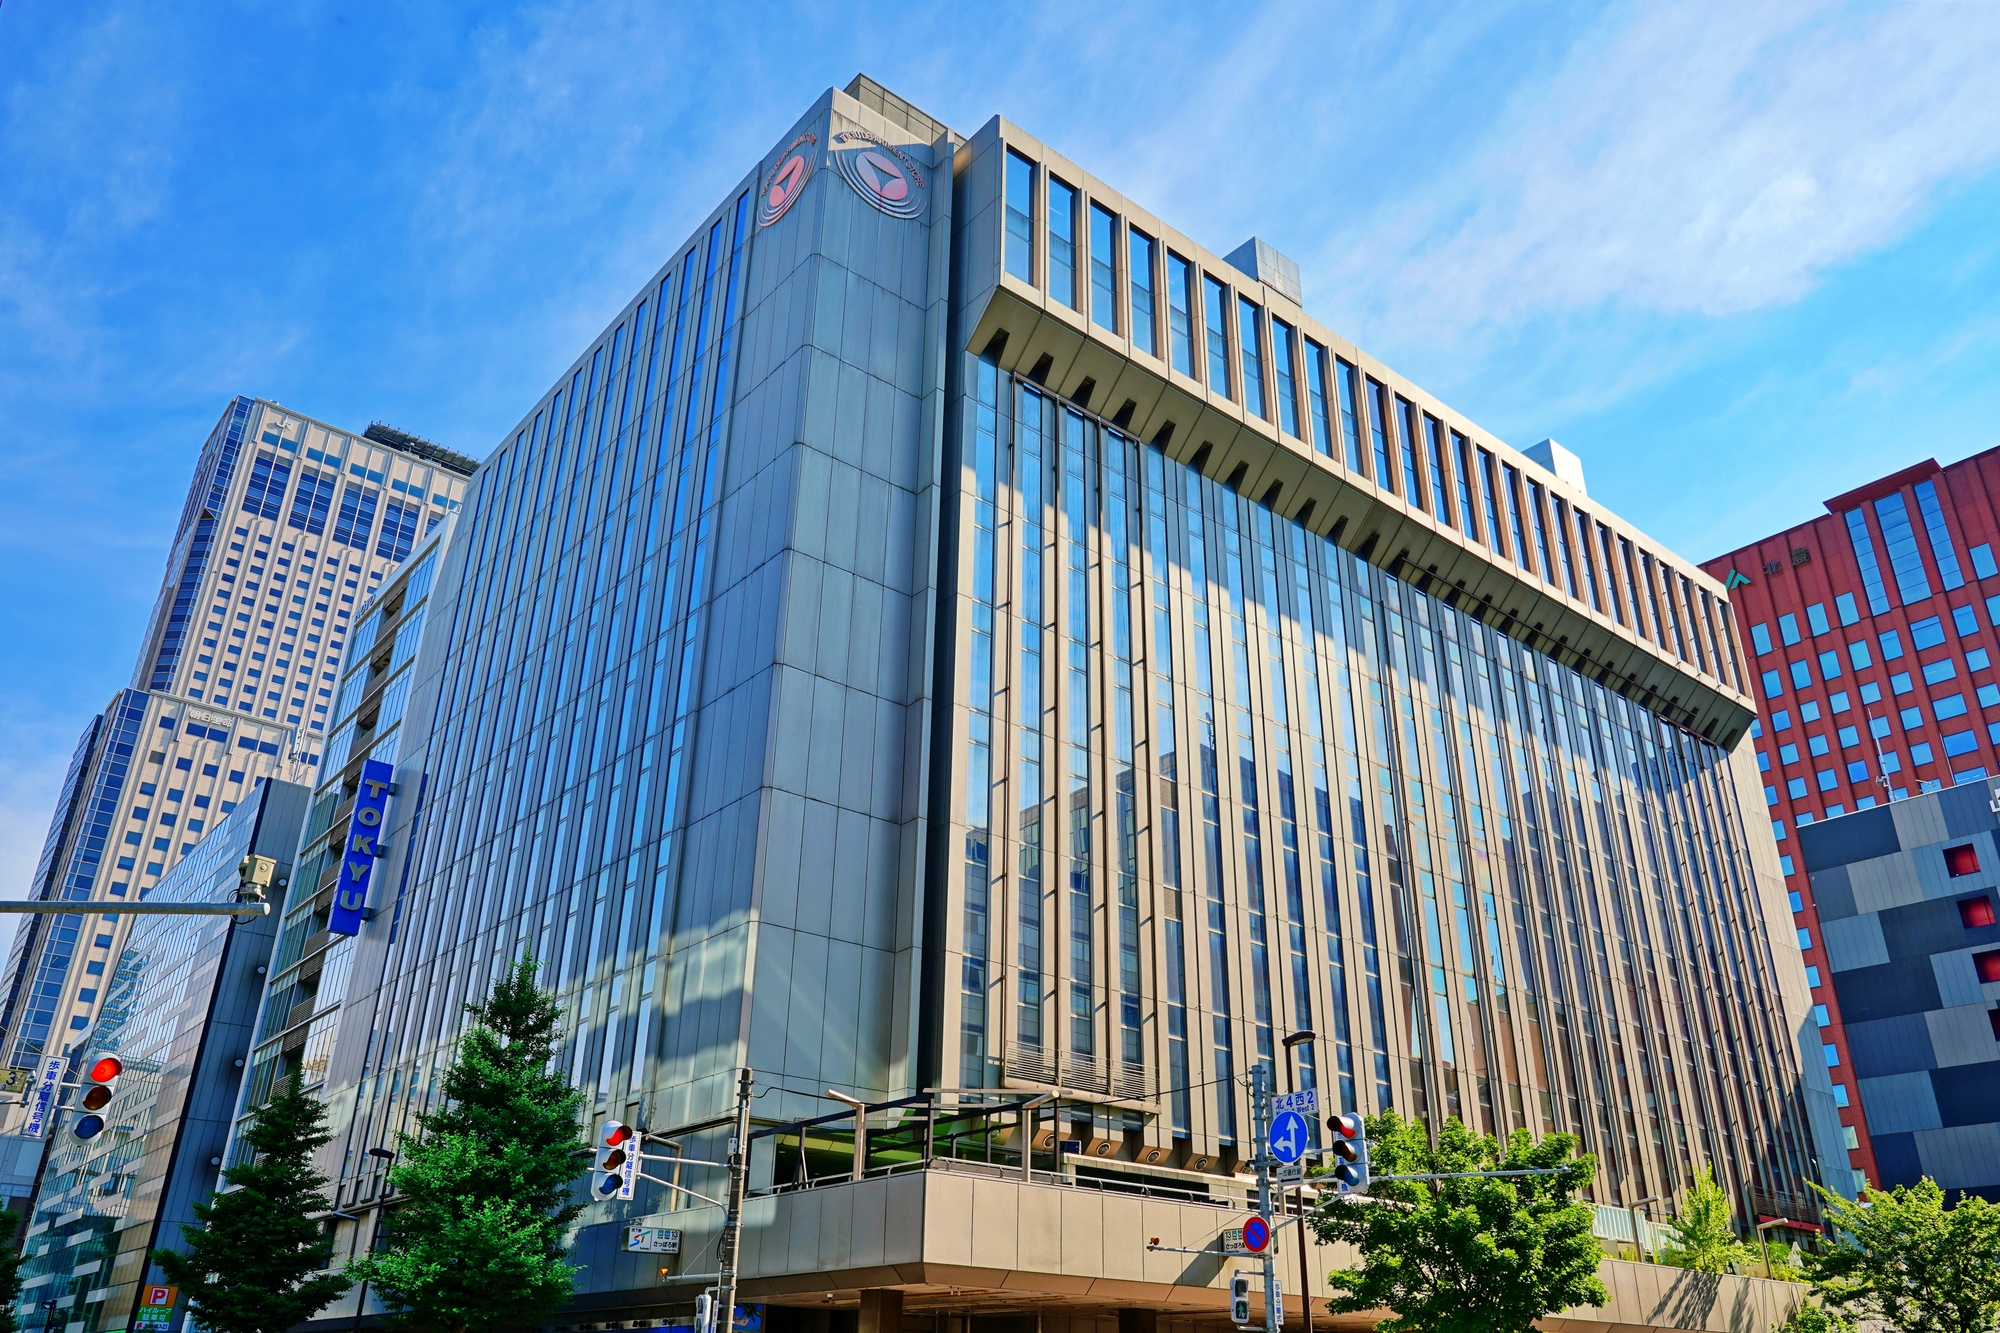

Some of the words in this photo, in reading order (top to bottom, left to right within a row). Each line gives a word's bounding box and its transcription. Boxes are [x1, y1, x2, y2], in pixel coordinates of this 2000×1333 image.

[861, 132, 908, 162] DEPARTMENT
[276, 420, 292, 431] JR
[189, 709, 233, 728] 朝日生命
[340, 778, 388, 911] TOKYU
[28, 1060, 60, 1134] 歩車分離信号機
[671, 1230, 679, 1238] 13
[152, 1289, 167, 1304] P
